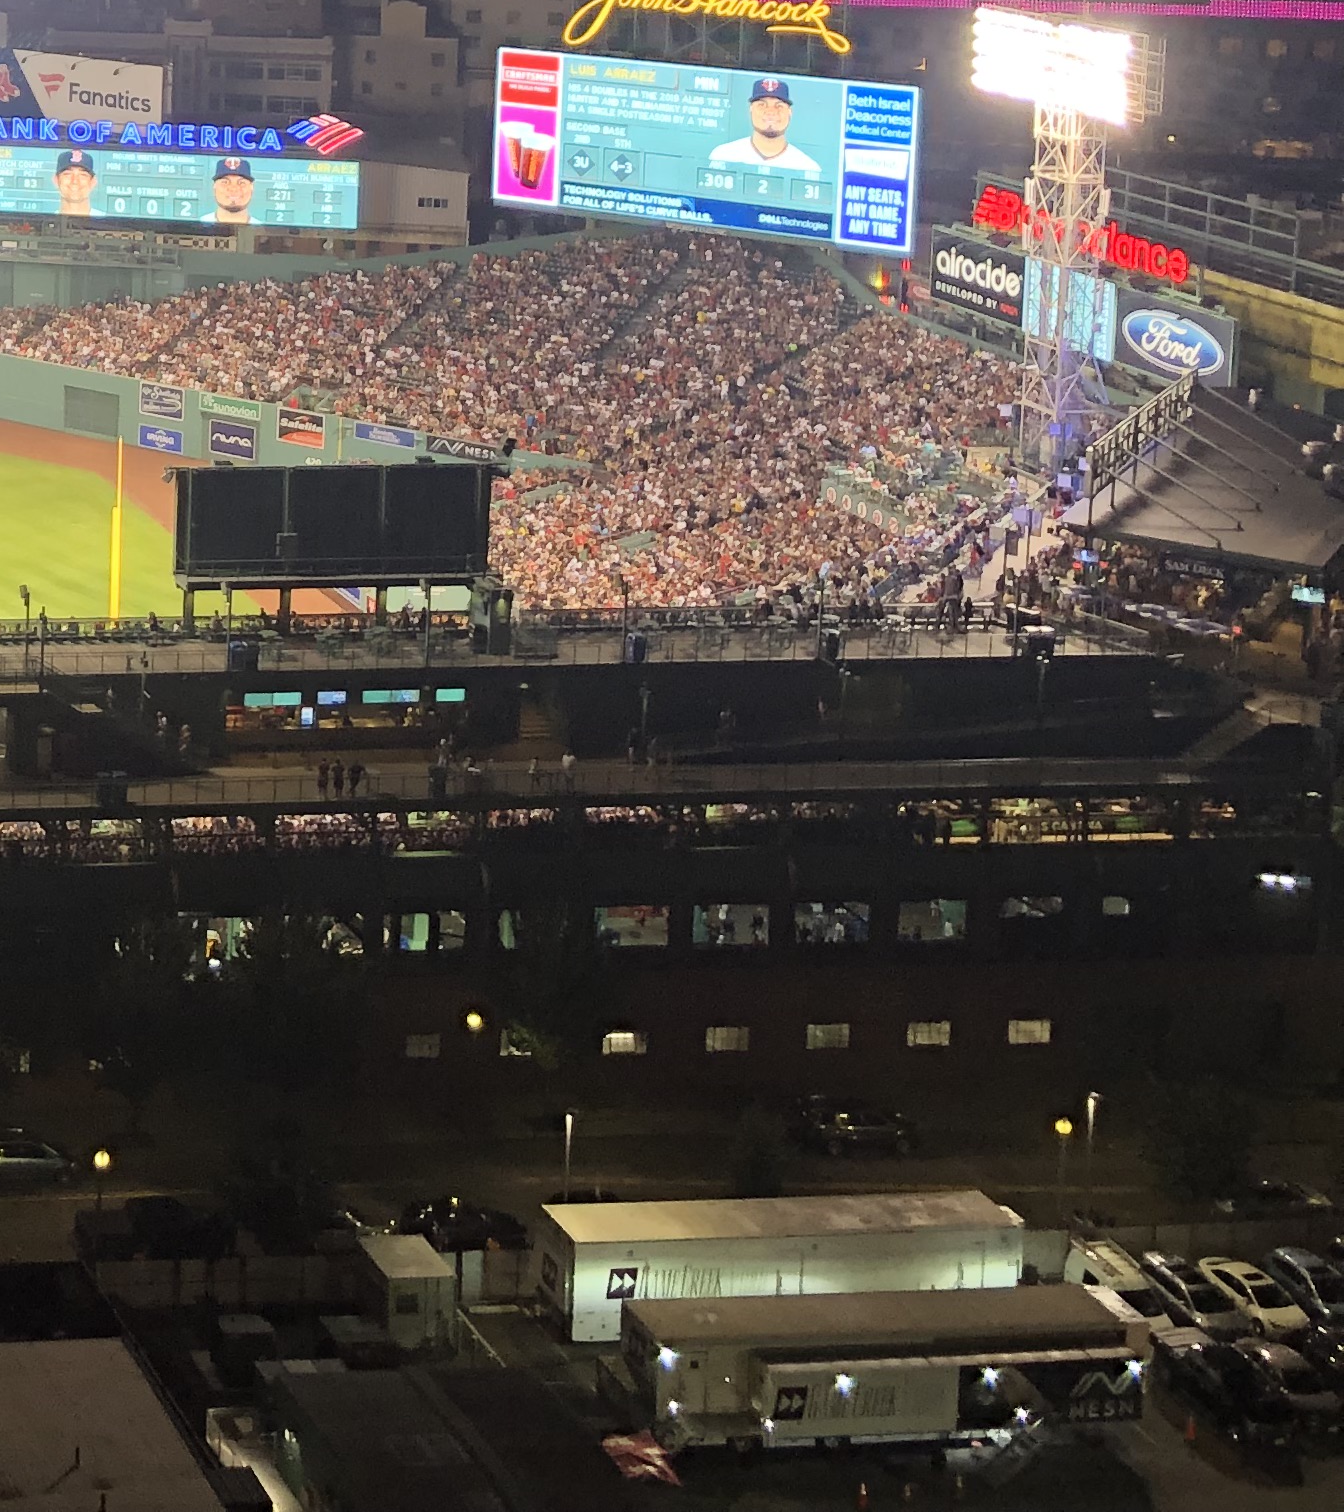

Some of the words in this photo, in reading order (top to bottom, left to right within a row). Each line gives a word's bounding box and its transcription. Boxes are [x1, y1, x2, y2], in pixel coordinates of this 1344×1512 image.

[569, 63, 597, 77] LUIS
[68, 82, 151, 113] Fanatics
[848, 93, 877, 109] Beth
[878, 96, 911, 112] Israel
[846, 108, 912, 126] Deaconess
[68, 119, 113, 144] OF
[119, 122, 283, 152] AMERICA
[566, 122, 601, 134] SECOND
[602, 126, 627, 137] BASE
[845, 123, 880, 137] Medical
[880, 126, 911, 140] Center
[610, 160, 633, 174] 4-3
[106, 186, 133, 195] BALLS
[175, 189, 198, 198] OUTS
[563, 184, 627, 202] TECHNOLOGY
[628, 191, 683, 208] SOLUTIONS
[757, 179, 768, 194] 2
[804, 184, 820, 200] 31
[845, 185, 867, 201] ANY
[868, 186, 905, 208] SEATS,
[114, 197, 126, 213] 0
[146, 199, 158, 215] 0
[180, 201, 192, 217] 2
[563, 194, 582, 206] FOR
[582, 196, 598, 208] ALL
[599, 198, 615, 210] OF
[616, 200, 645, 214] LIFE'S
[646, 204, 679, 219] CURVE
[845, 201, 868, 219] ANY
[868, 203, 903, 224] GAME,
[781, 216, 829, 231] Technologies
[848, 218, 871, 236] ANY
[872, 221, 898, 240] TIME
[935, 246, 1022, 298] airocide
[934, 279, 984, 306] DEVELOPED
[986, 296, 998, 310] BY
[1140, 317, 1200, 367] Ford
[213, 401, 258, 418] sunovion
[279, 417, 323, 434] Safelite
[212, 432, 253, 448] nuna
